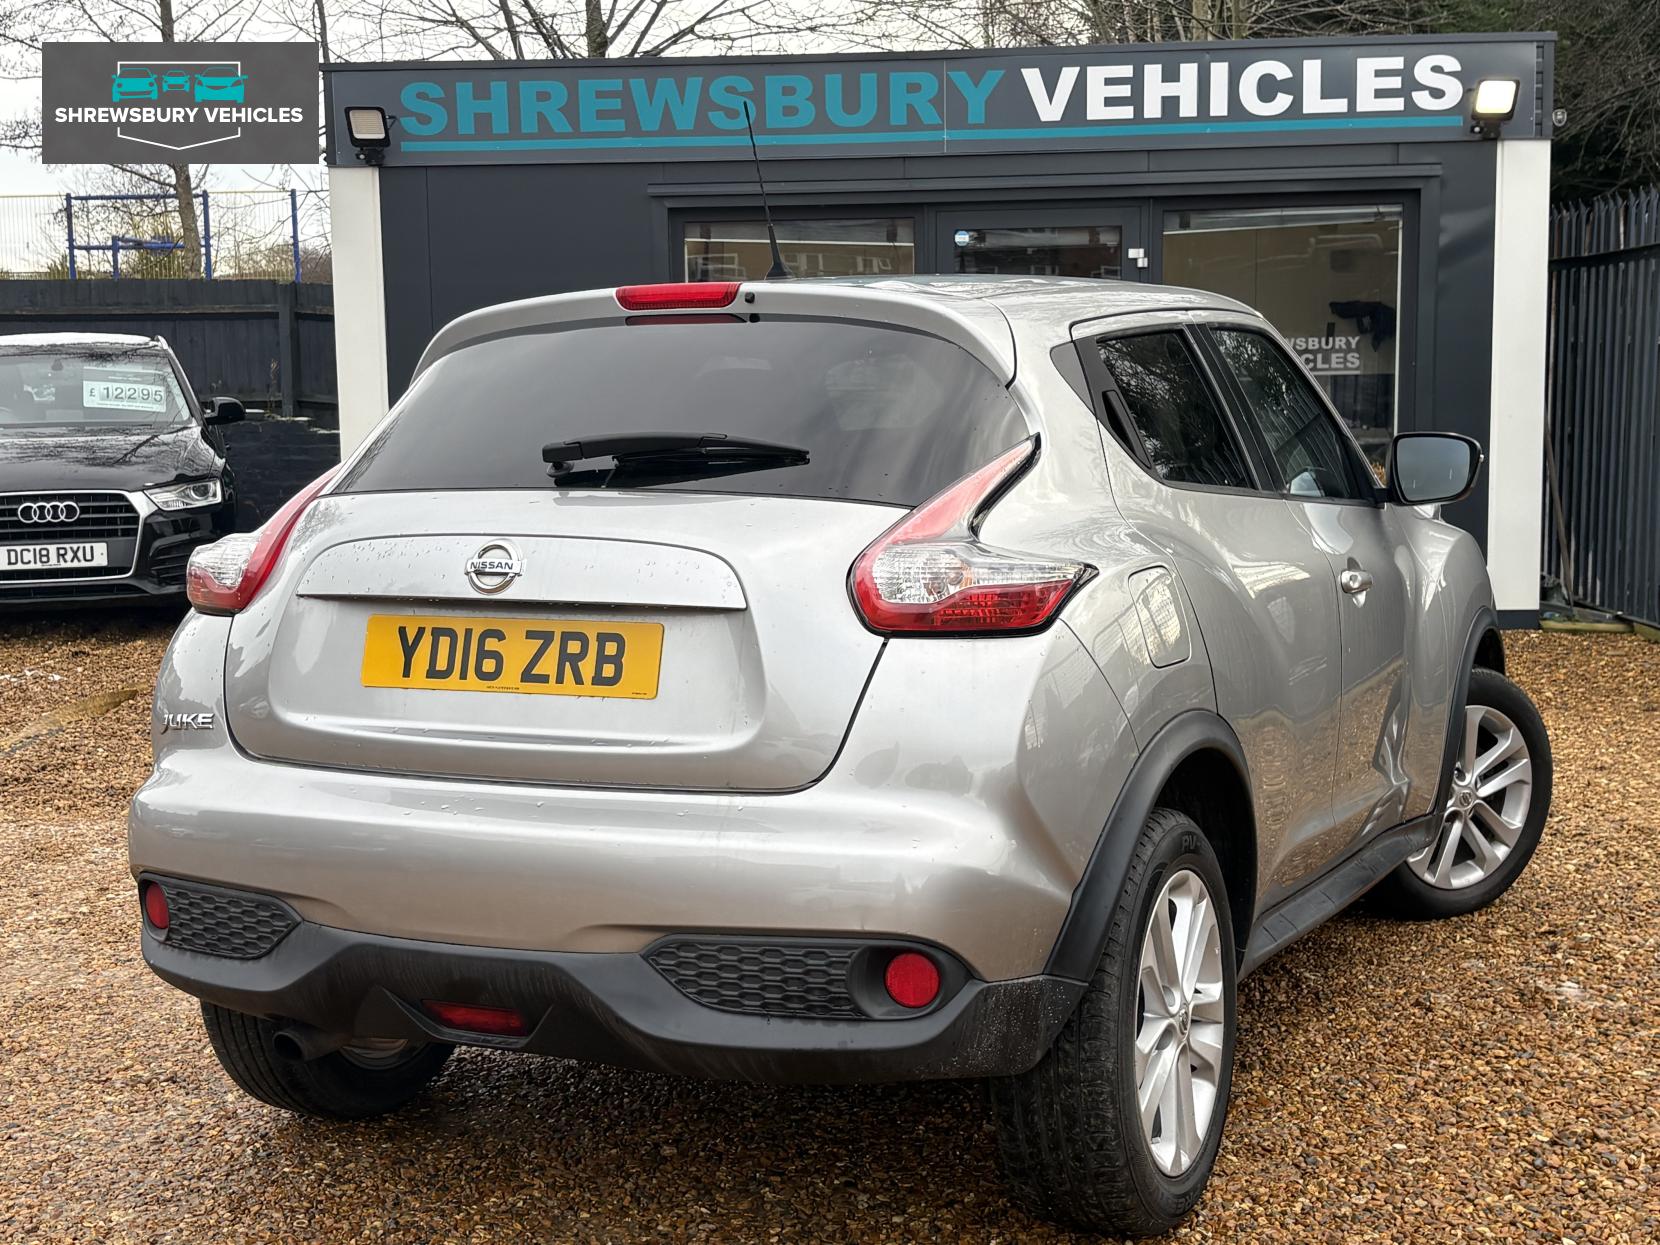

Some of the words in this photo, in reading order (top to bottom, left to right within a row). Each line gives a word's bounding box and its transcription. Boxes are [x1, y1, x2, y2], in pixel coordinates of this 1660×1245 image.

[400, 69, 1005, 135] SHREWSBURY
[1020, 54, 1465, 122] VEHICLES
[103, 386, 163, 403] 12295
[6, 547, 50, 566] DC18
[56, 545, 94, 563] RXU
[470, 561, 514, 570] NISSAN
[398, 626, 506, 682] YD16
[520, 630, 626, 687] ZRB
[161, 713, 215, 734] JUKE
